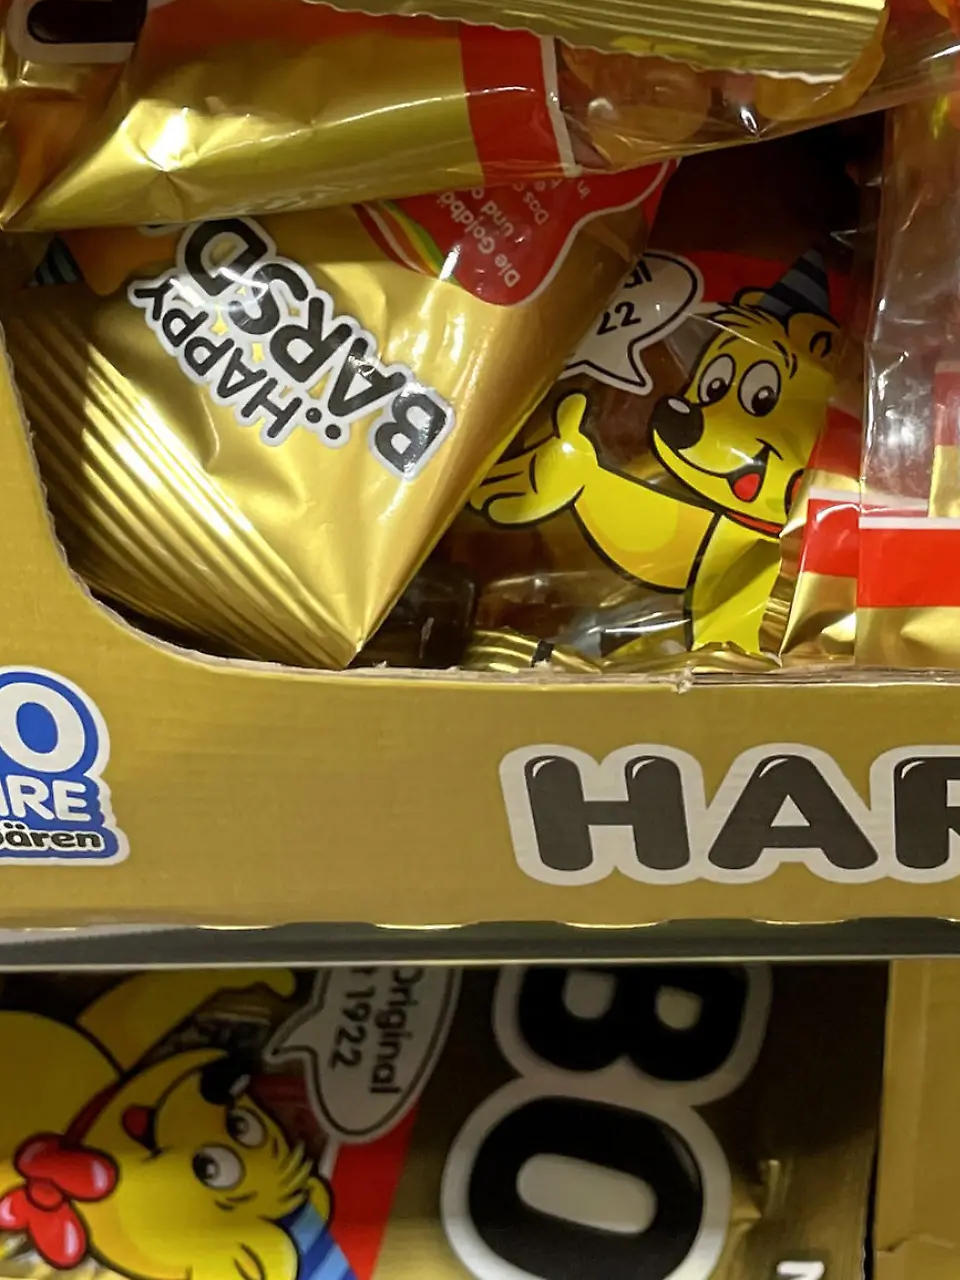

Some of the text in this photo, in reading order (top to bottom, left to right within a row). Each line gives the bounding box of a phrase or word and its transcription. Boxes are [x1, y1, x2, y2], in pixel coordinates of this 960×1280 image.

[436, 191, 520, 288] Die Goldbä
[480, 200, 514, 238] und
[522, 191, 549, 225] Das
[132, 274, 304, 440] HAPPY
[183, 216, 448, 474] BÄRSD
[329, 984, 376, 1070] 1922
